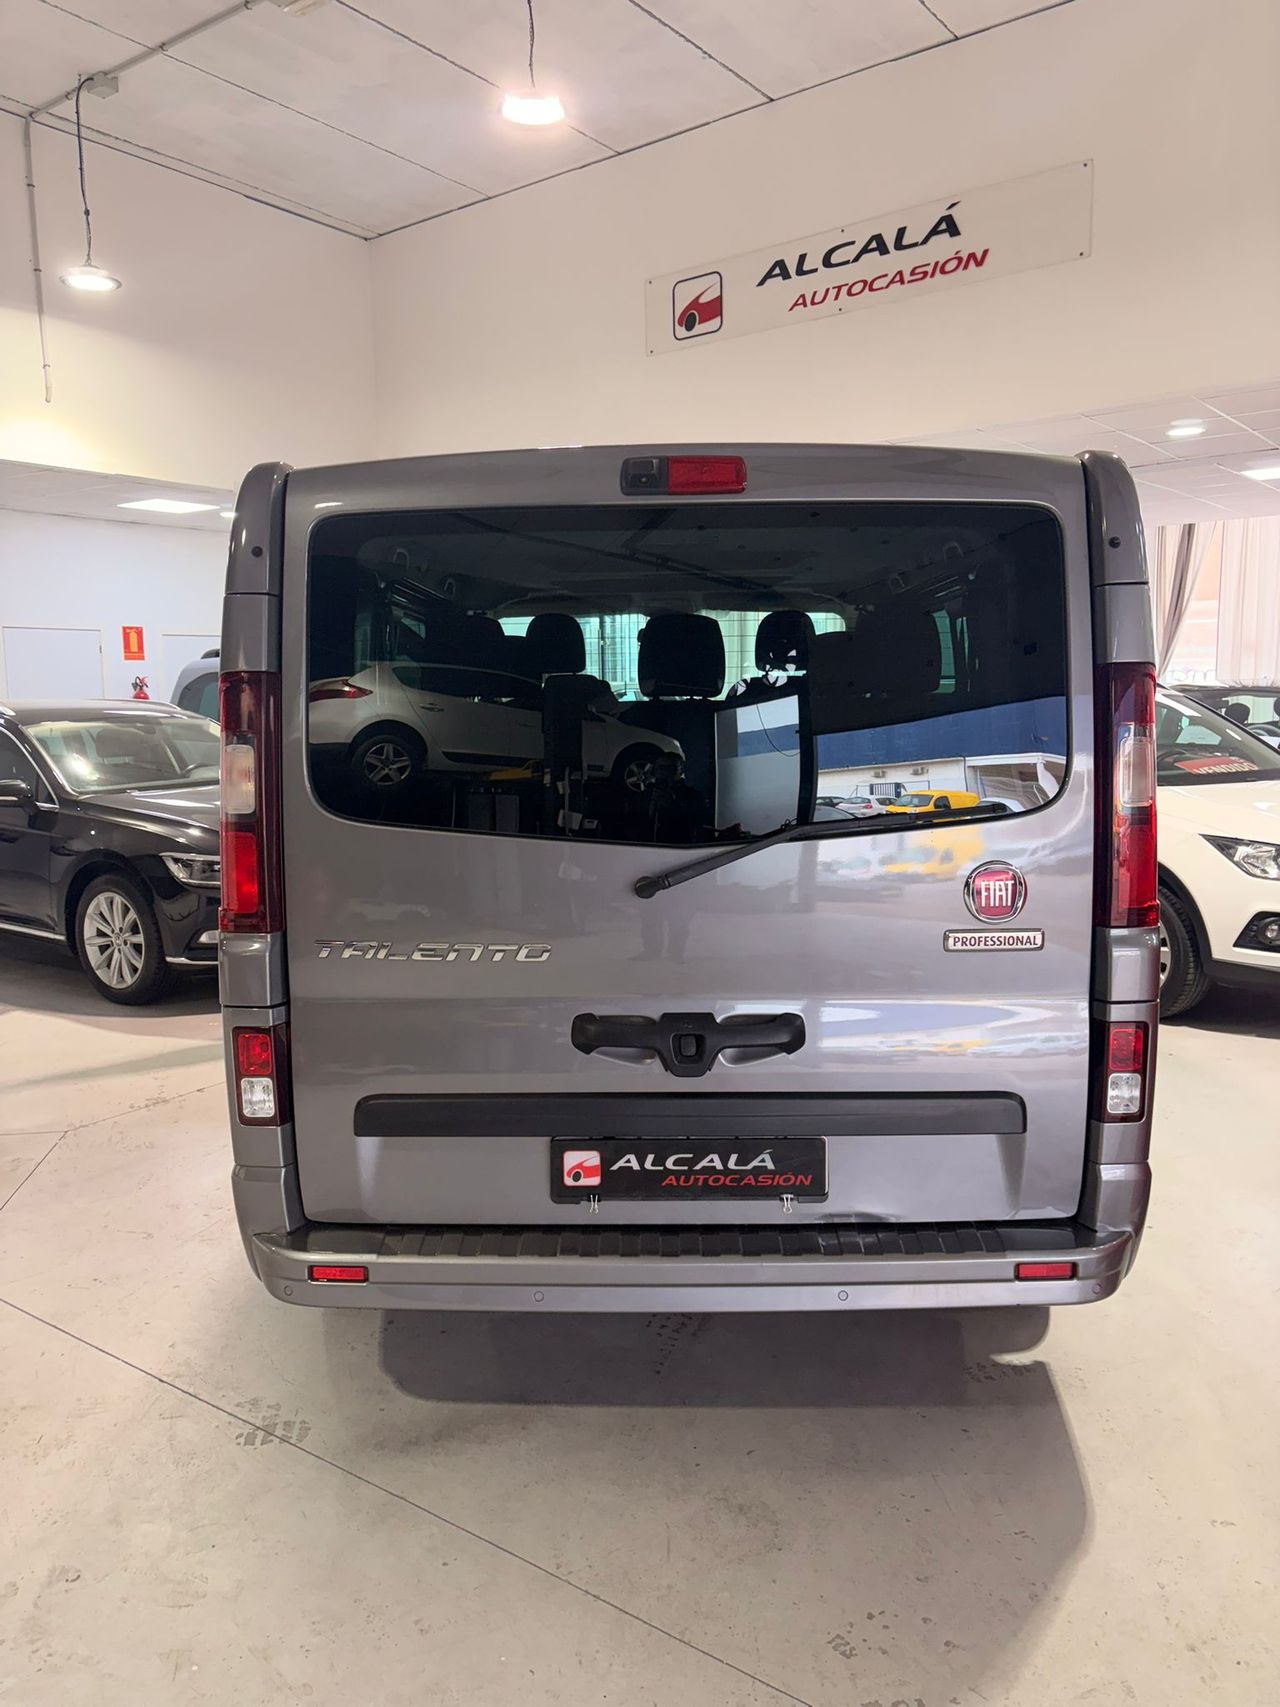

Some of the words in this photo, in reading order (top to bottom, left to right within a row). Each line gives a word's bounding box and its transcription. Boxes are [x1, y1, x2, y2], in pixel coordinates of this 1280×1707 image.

[756, 200, 962, 287] ALCALÁ
[788, 248, 990, 312] AUTOCASIÓN
[981, 880, 1015, 908] FIAT
[314, 939, 552, 962] TALENTO
[952, 935, 1039, 947] PROFESSIONAL
[609, 1149, 776, 1171] ALCALÁ
[661, 1172, 813, 1187] AUTOCASIÓN
